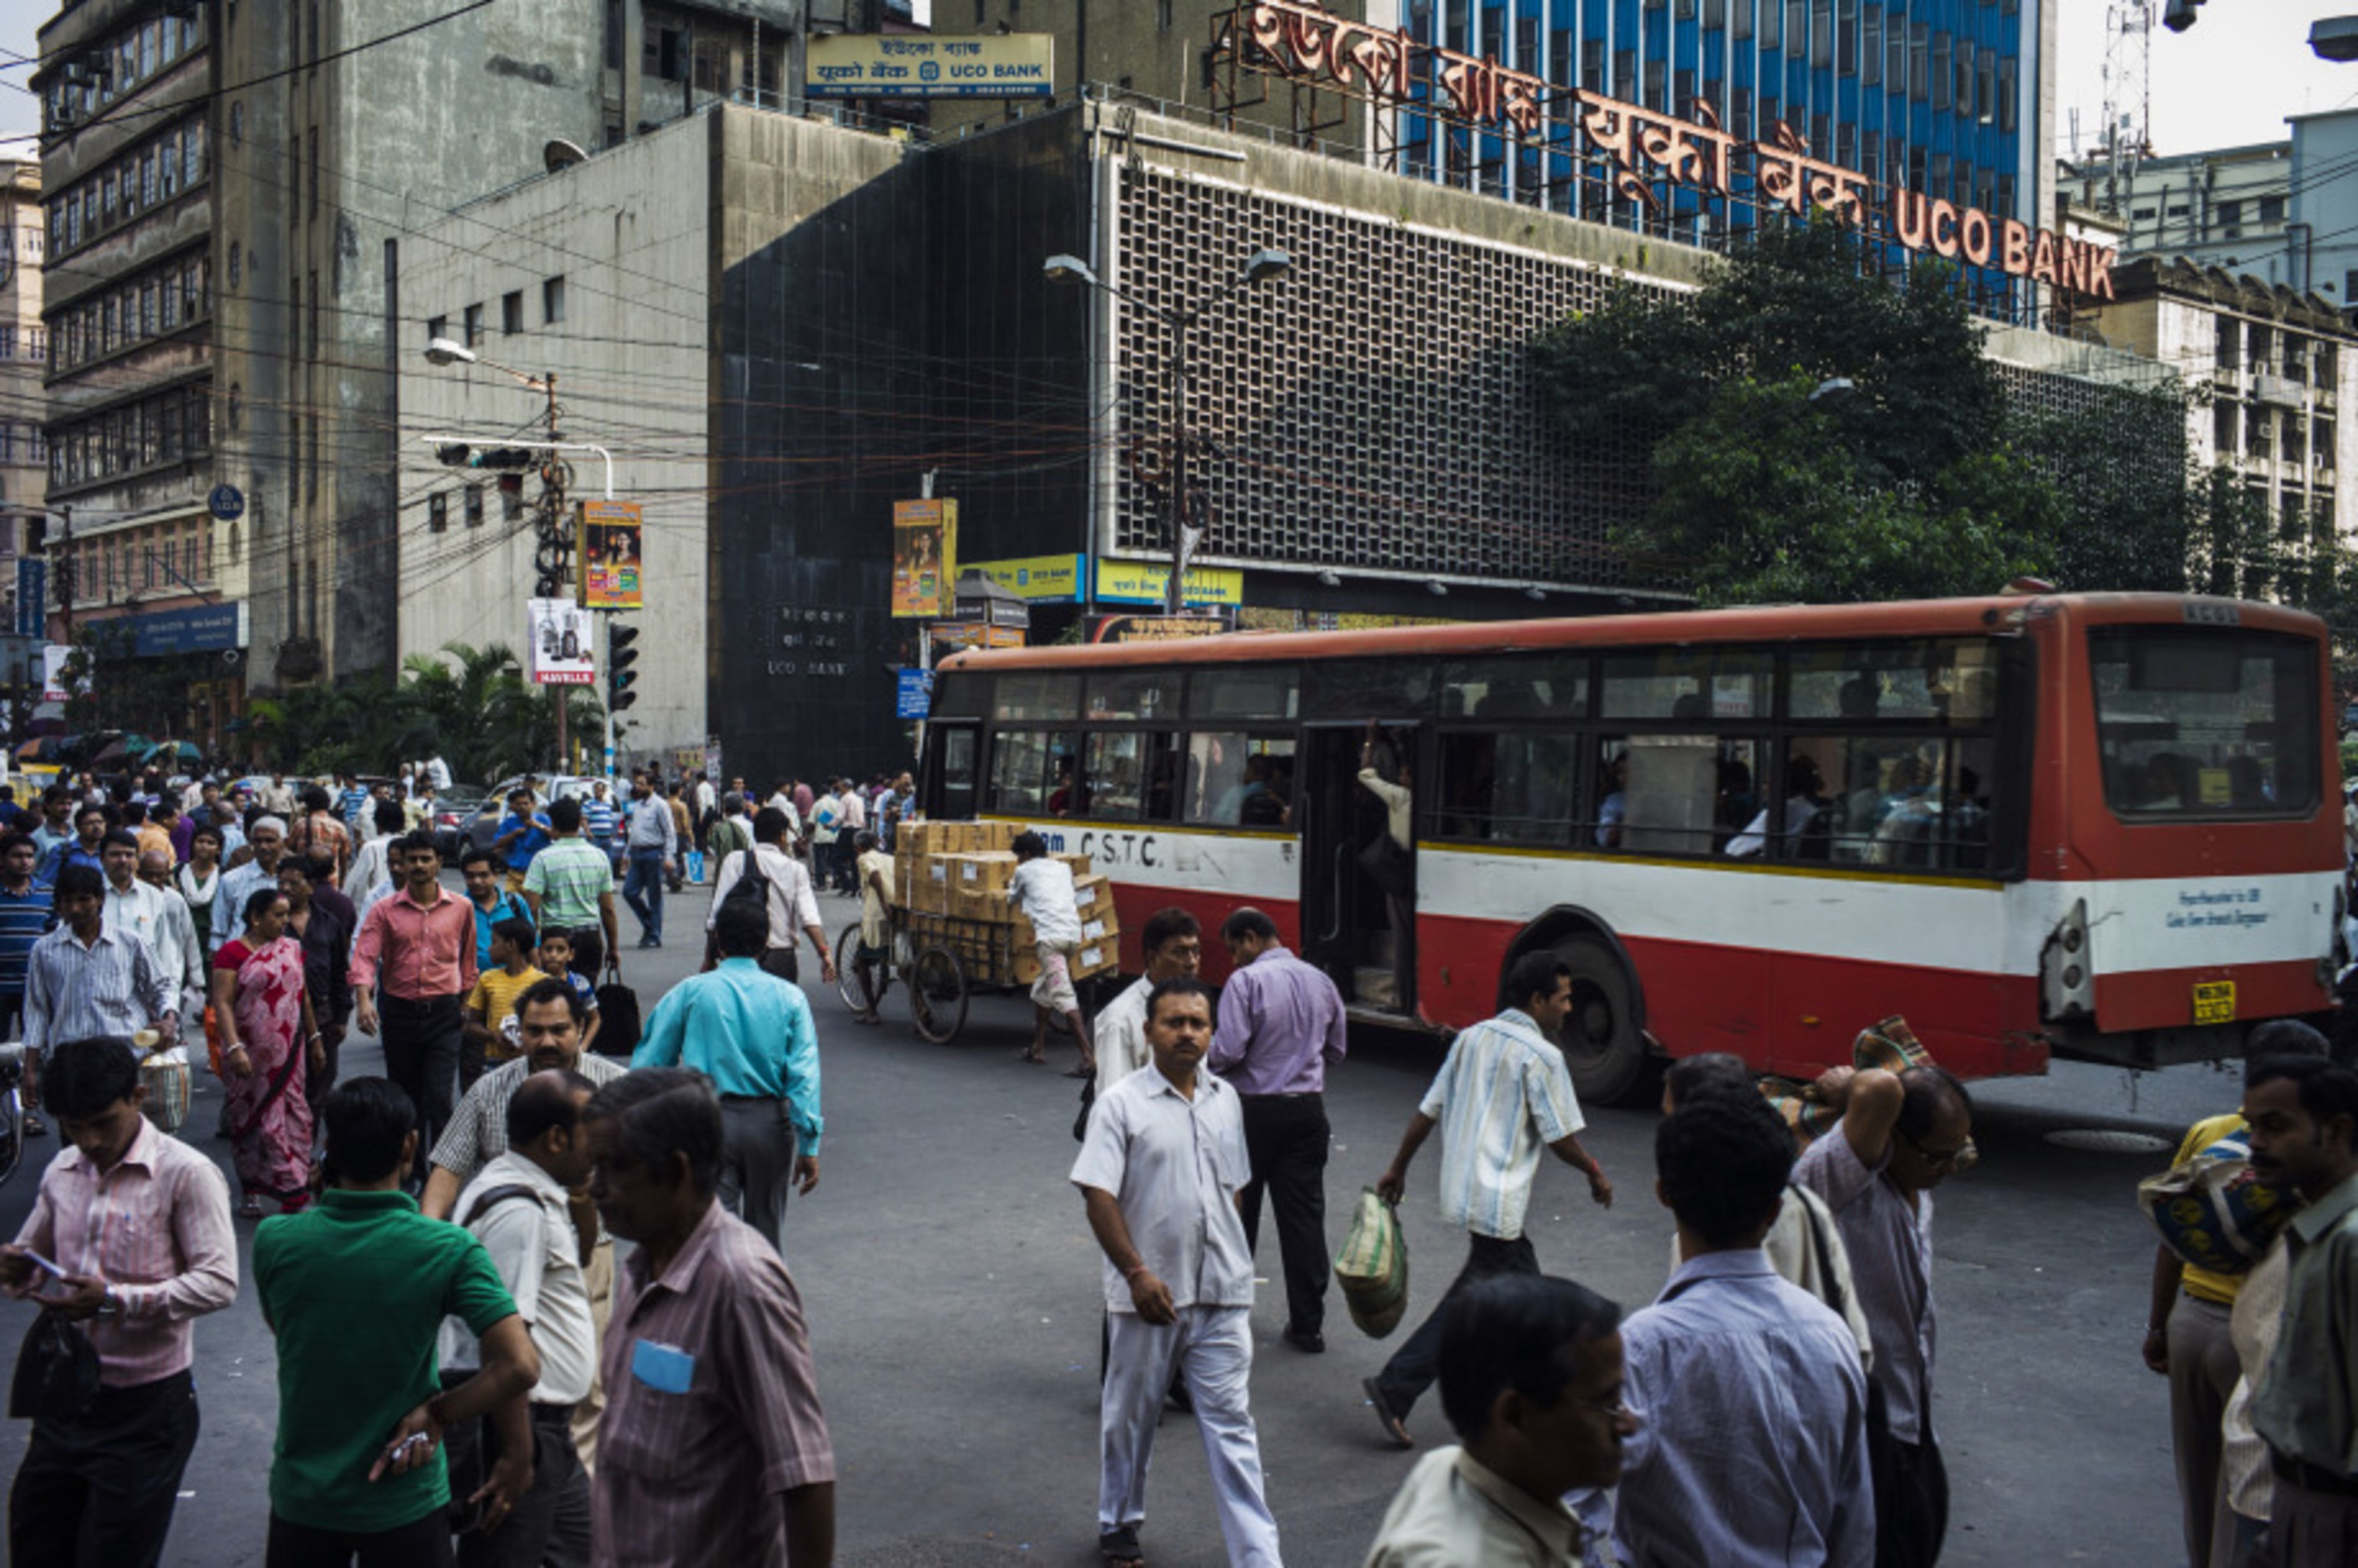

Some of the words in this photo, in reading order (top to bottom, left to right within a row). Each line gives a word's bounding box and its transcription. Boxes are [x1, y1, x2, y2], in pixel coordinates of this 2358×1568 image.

[816, 61, 863, 81] यूको
[950, 64, 987, 78] UCO
[993, 64, 1043, 78] BANK
[1573, 87, 1737, 212] यूको
[1892, 187, 1991, 266] UCO
[2000, 218, 2117, 301] BANK
